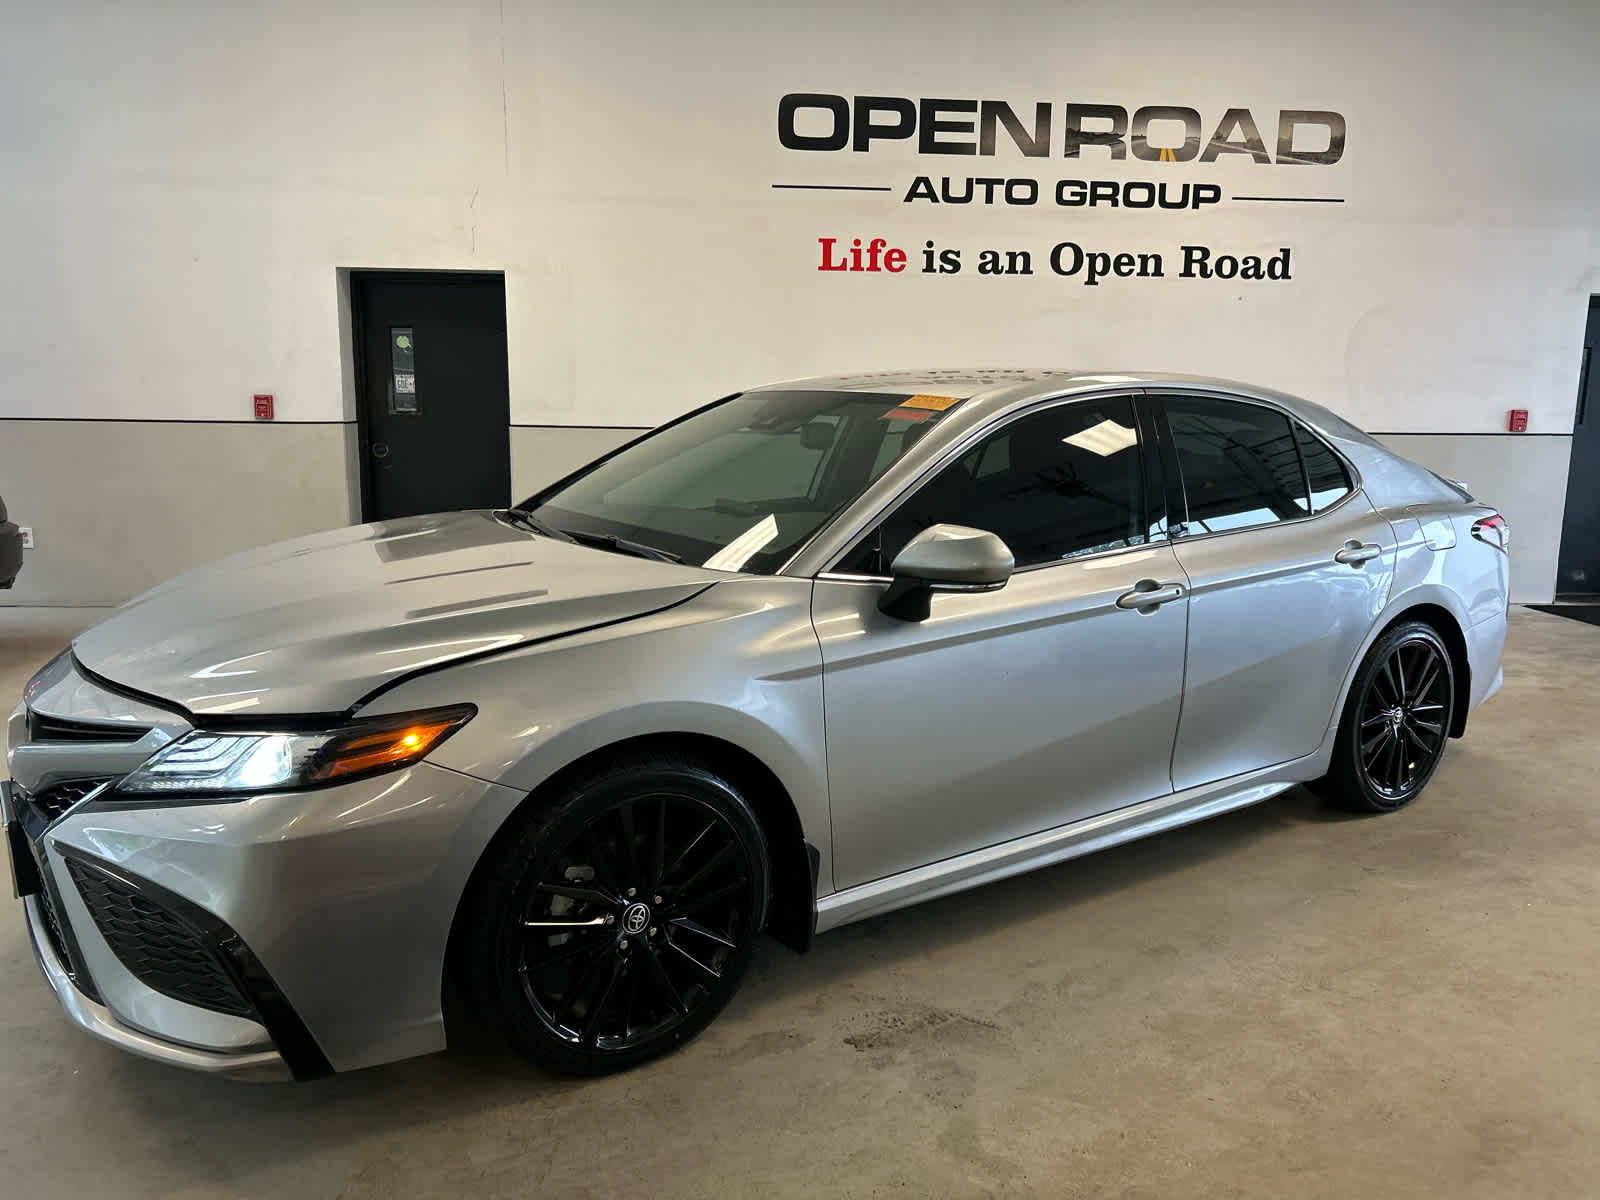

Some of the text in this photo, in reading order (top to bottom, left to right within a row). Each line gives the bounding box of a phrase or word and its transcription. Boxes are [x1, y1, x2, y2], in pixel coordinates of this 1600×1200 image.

[777, 93, 1347, 166] OPEN ROAD
[903, 176, 1222, 210] AUTO GROUP
[817, 237, 1292, 287] Life is an Open Road
